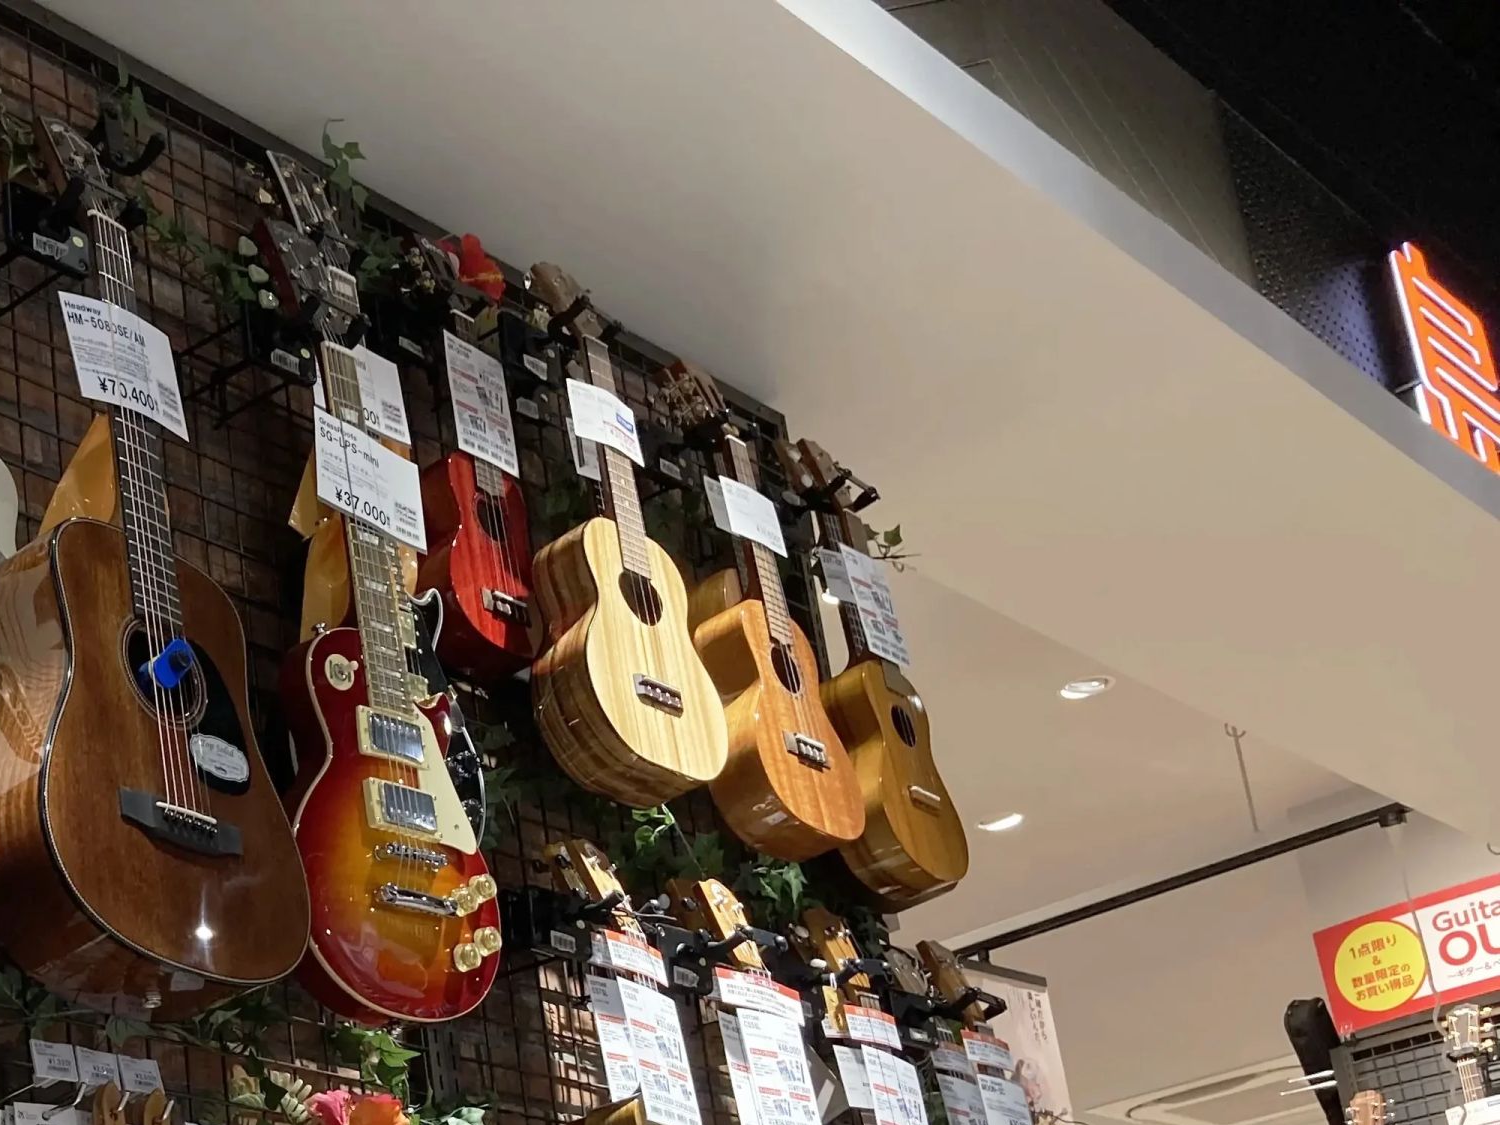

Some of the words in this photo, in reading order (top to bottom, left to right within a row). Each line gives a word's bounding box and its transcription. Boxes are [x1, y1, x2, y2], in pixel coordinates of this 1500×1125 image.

[99, 376, 155, 411] ¥70,400
[335, 487, 388, 526] ¥37,000
[1349, 934, 1397, 960] 1点限り
[1372, 955, 1382, 966] &
[1351, 963, 1411, 989] 数量限定の
[1355, 975, 1415, 1002] お買い得品
